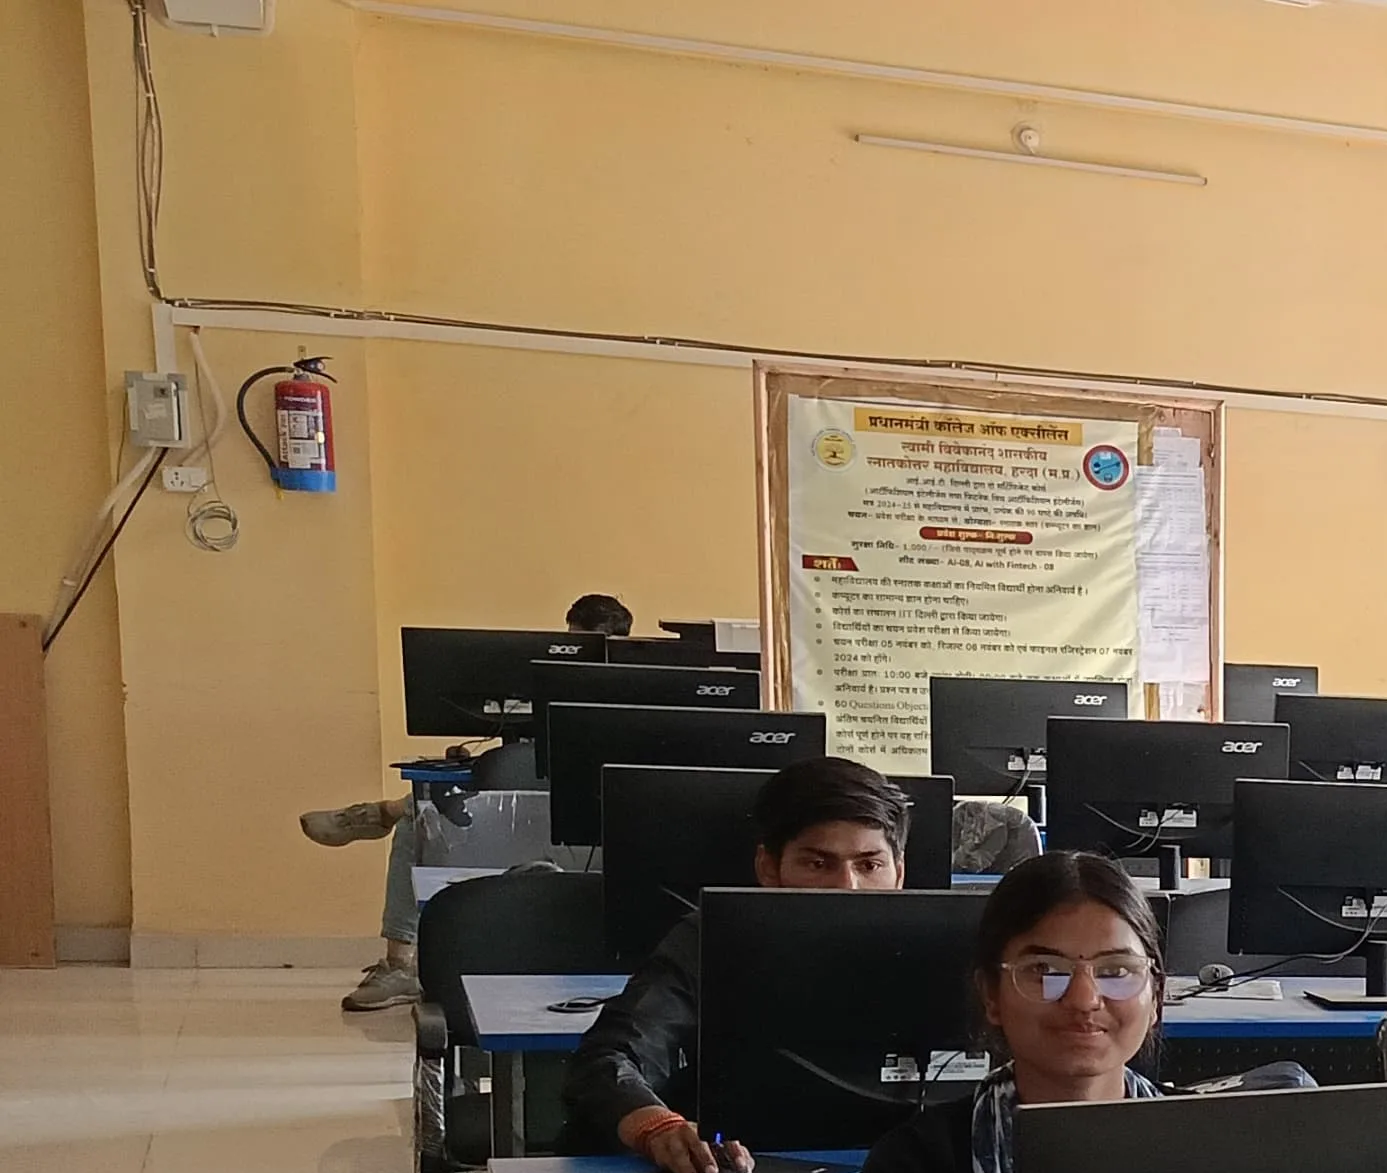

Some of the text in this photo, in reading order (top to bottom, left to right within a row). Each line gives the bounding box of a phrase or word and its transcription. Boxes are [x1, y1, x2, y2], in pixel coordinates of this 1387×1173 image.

[869, 415, 1069, 441] प्रधानमंत्री कॉलेज ऑफ एक्सीलेंस
[901, 441, 1048, 461] स्वामी विवेकानंद शासकीय
[867, 455, 929, 469] स्नातकोत्तर
[986, 561, 1005, 569] with
[1006, 561, 1037, 570] Fintech
[832, 575, 879, 586] महाविद्यालय
[893, 579, 922, 588] स्नातक
[549, 645, 582, 654] acer
[834, 653, 858, 662] 2024
[861, 652, 872, 662] को
[884, 670, 912, 679] 10:00
[1273, 678, 1300, 686] acer
[697, 686, 734, 695] acer
[849, 700, 895, 710] Questions
[1075, 695, 1107, 705] acer
[750, 732, 795, 743] acer
[1222, 742, 1262, 752] acer
